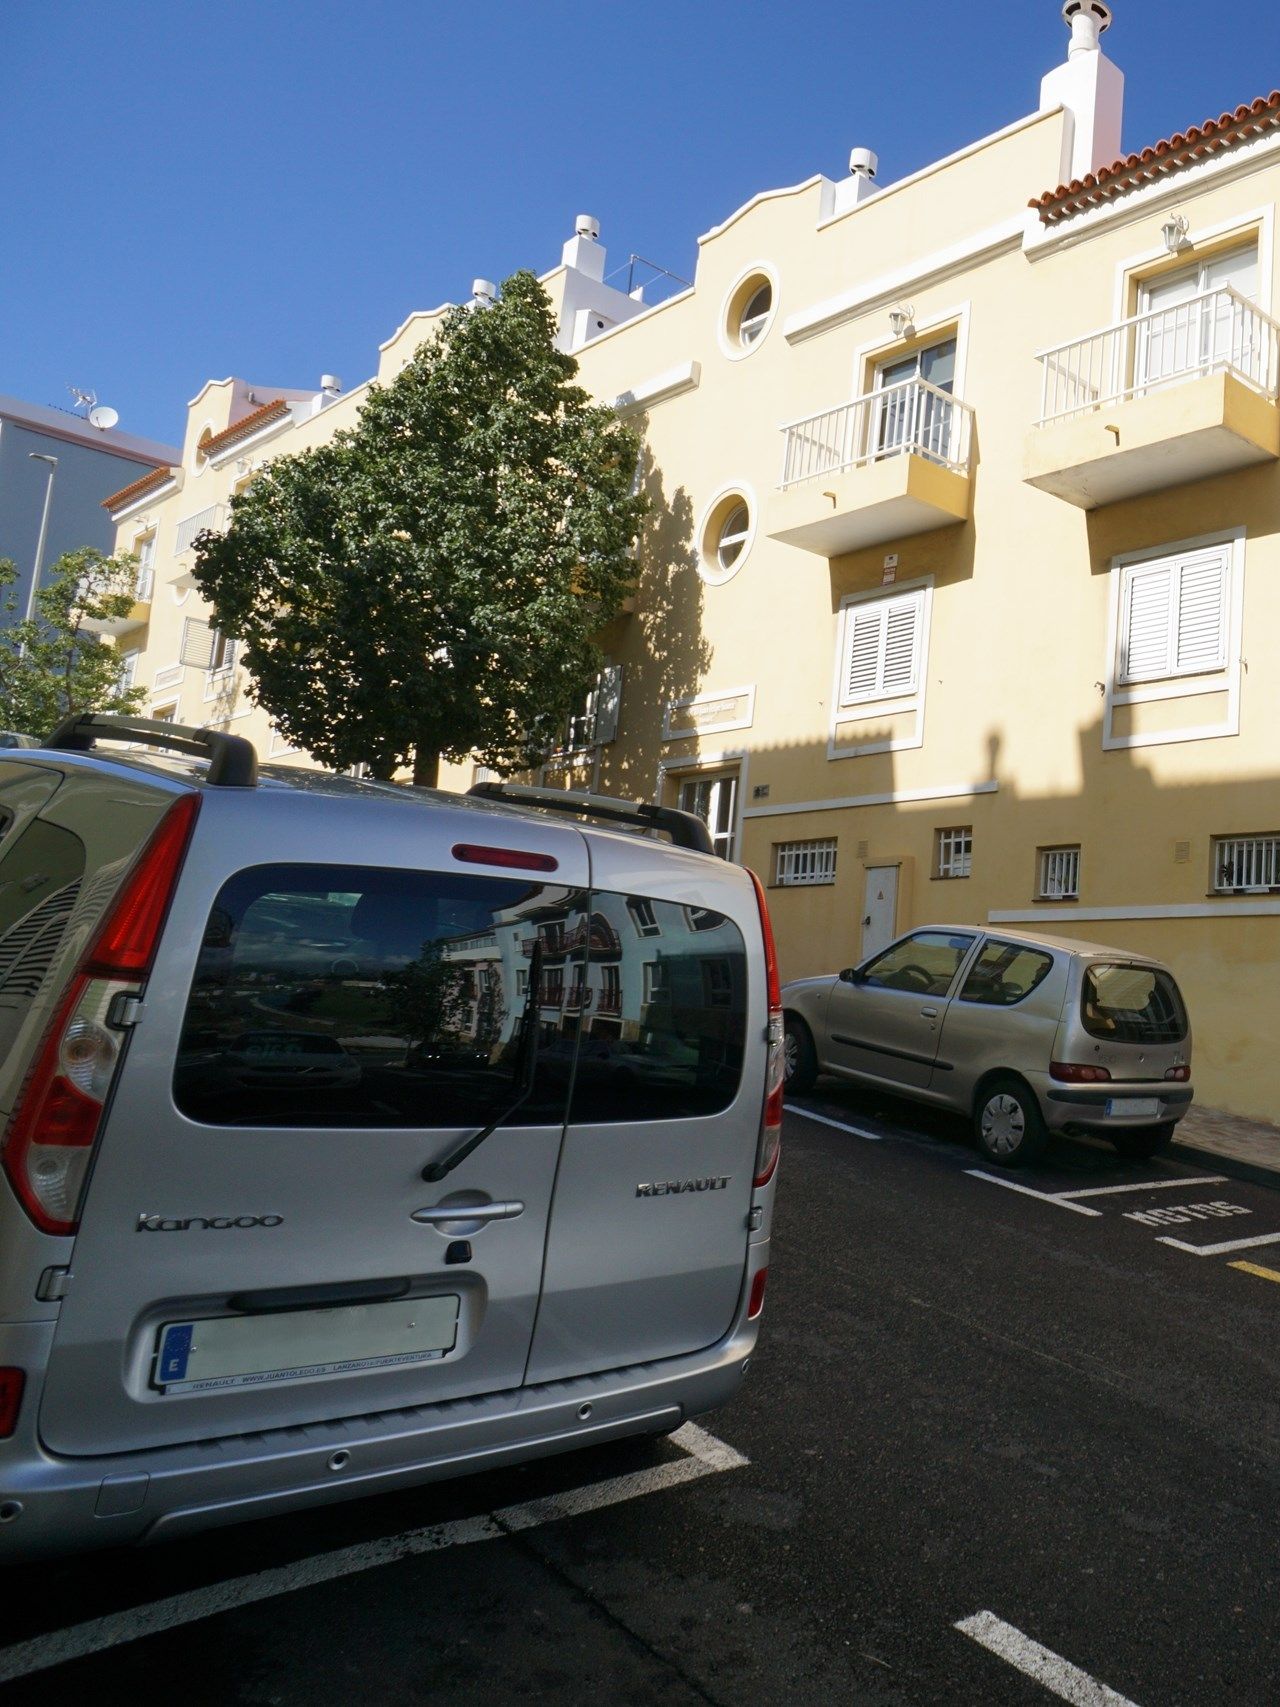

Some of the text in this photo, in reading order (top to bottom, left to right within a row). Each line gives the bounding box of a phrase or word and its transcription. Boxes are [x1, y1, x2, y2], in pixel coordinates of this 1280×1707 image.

[636, 1176, 732, 1198] RENAULT
[135, 1213, 284, 1232] Kangoo
[169, 1359, 180, 1372] E
[192, 1379, 236, 1390] RENAULT
